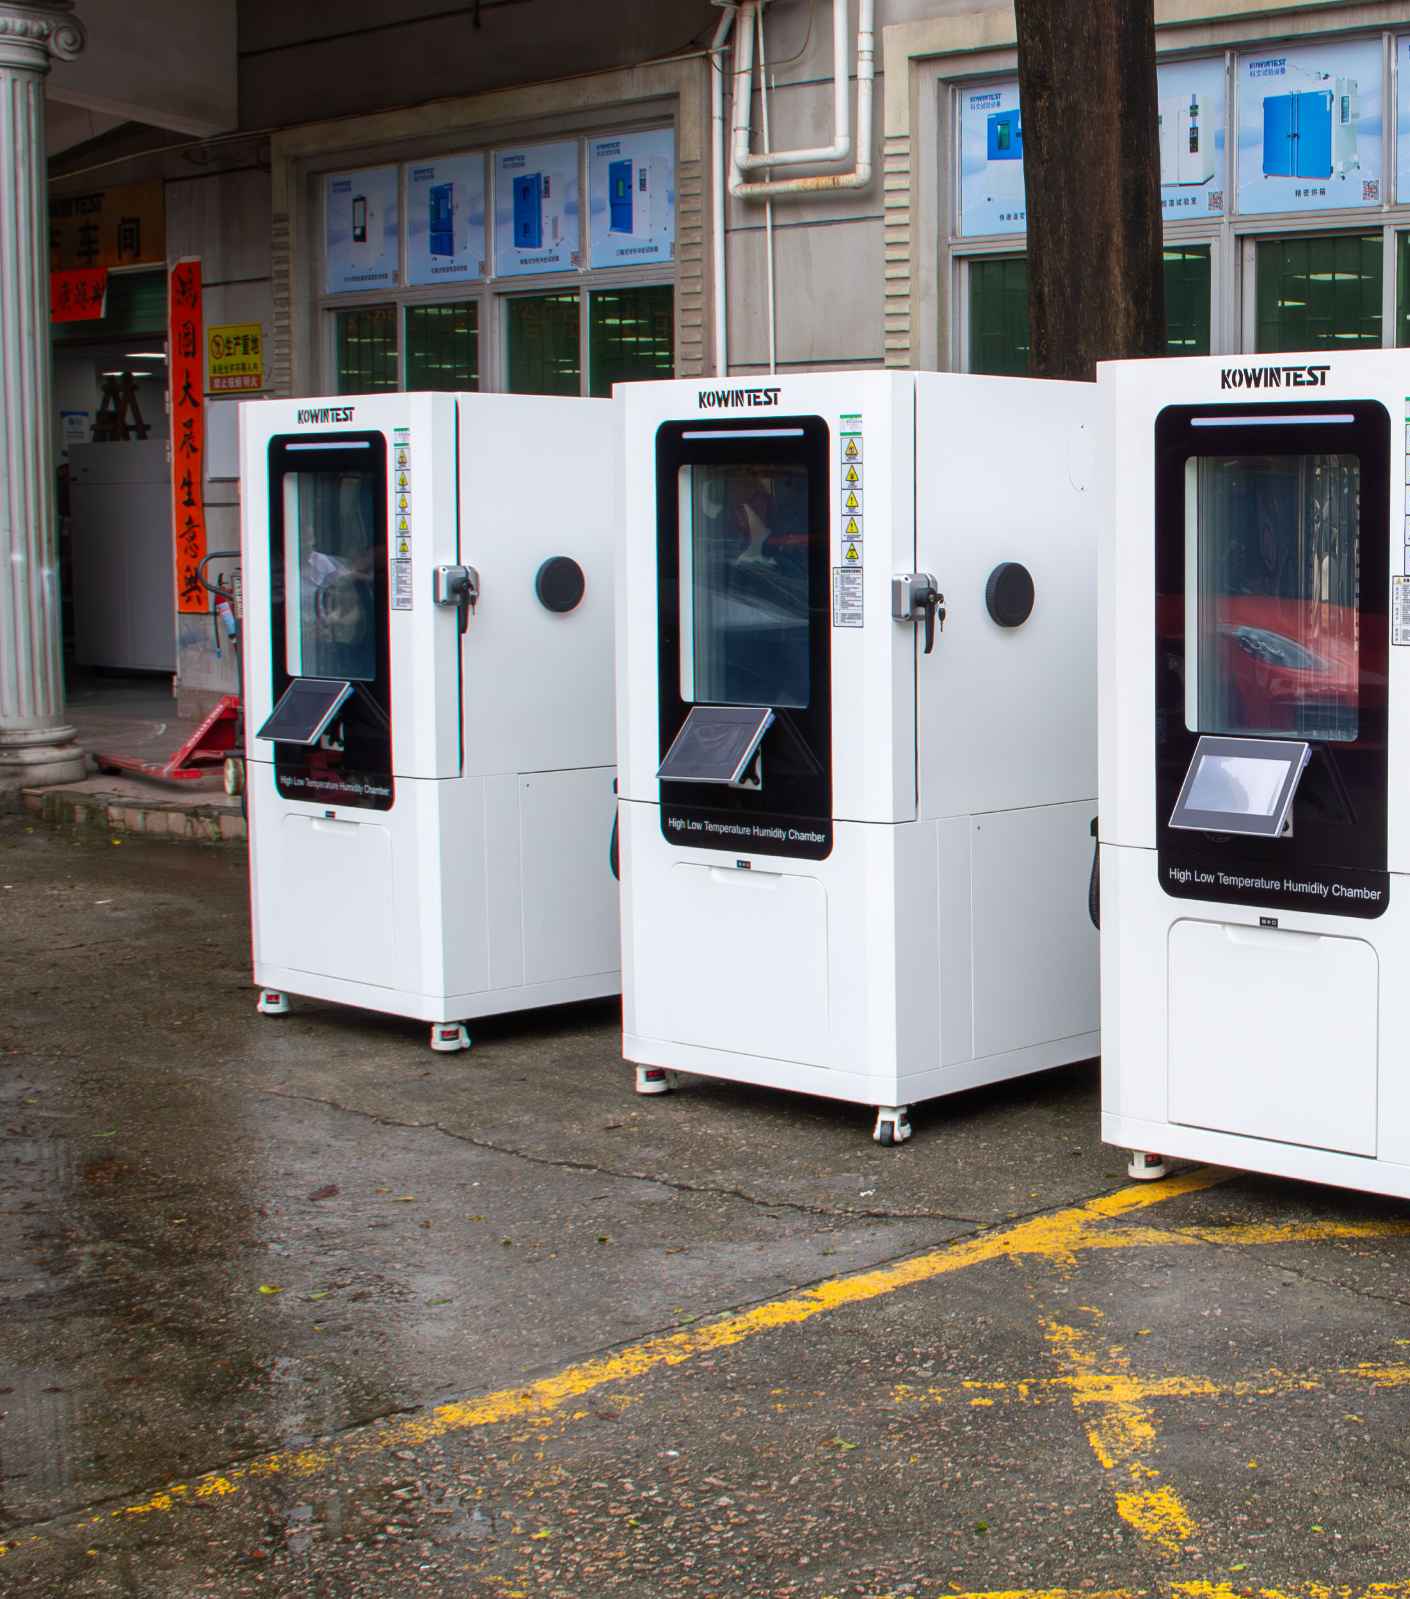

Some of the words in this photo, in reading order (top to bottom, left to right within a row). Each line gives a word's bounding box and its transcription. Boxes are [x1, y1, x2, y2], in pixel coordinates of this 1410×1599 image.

[1220, 365, 1331, 389] KOWINTEST
[698, 388, 781, 409] KOWINTEST
[297, 406, 355, 424] KOWINTEST
[280, 775, 293, 787] High
[294, 777, 304, 786] Low
[305, 778, 339, 791] Temperature
[340, 782, 363, 794] Humidity
[364, 784, 391, 796] Chamber
[668, 817, 686, 830] High
[687, 819, 702, 830] Low
[704, 820, 750, 836] Temperature
[752, 826, 787, 841] Humidity
[788, 828, 826, 843] Chamber
[1169, 868, 1192, 883] High
[1194, 870, 1215, 883] Low
[1217, 872, 1281, 890] Temperature
[1283, 879, 1330, 897] Humidity
[1332, 884, 1382, 901] Chamber
